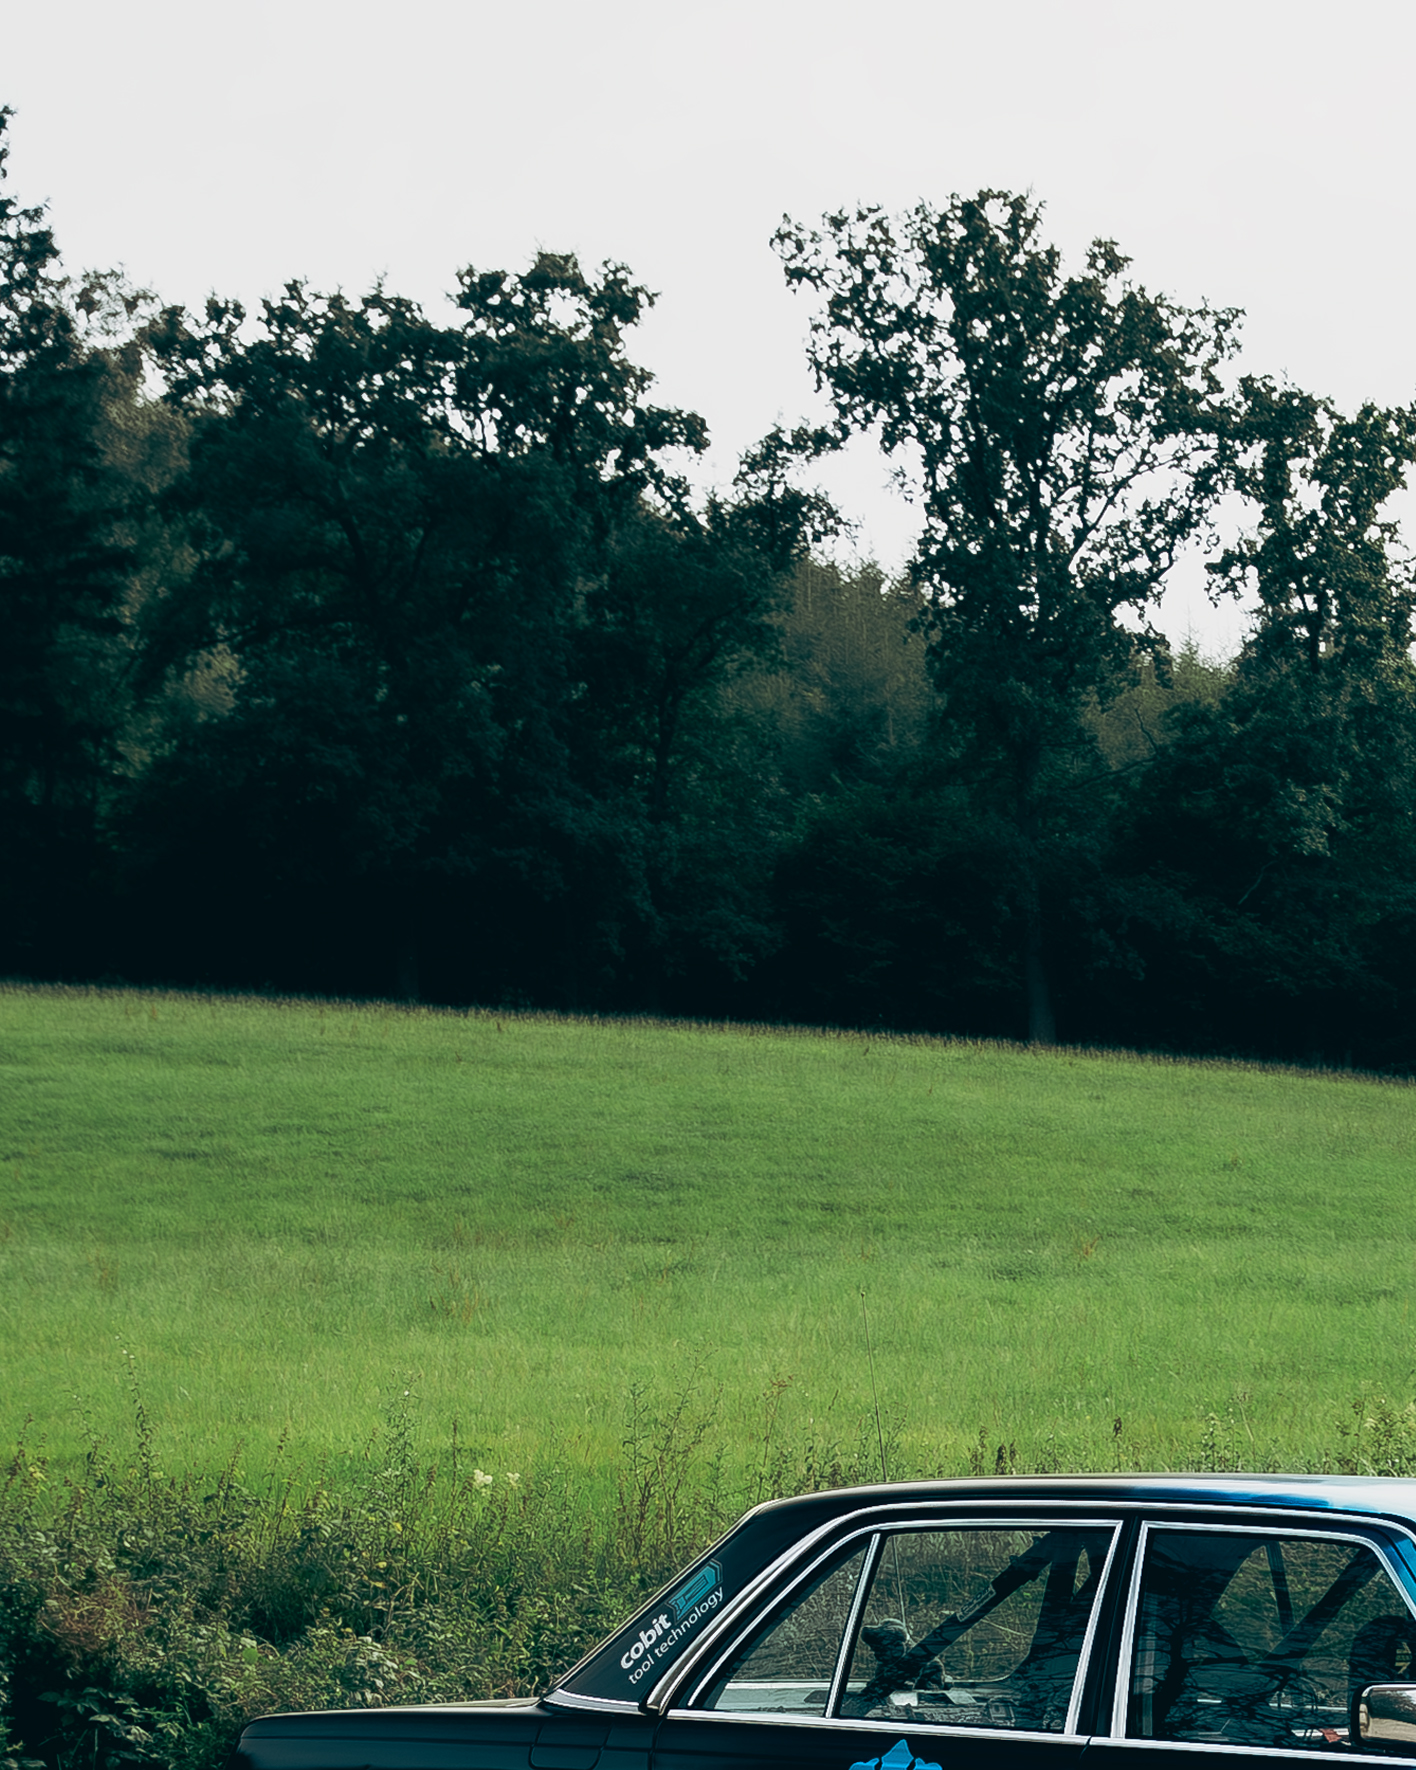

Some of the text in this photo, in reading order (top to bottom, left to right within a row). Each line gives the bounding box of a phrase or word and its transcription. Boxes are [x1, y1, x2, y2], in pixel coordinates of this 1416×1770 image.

[620, 1613, 672, 1669] cobit
[628, 1586, 724, 1685] tool technology
